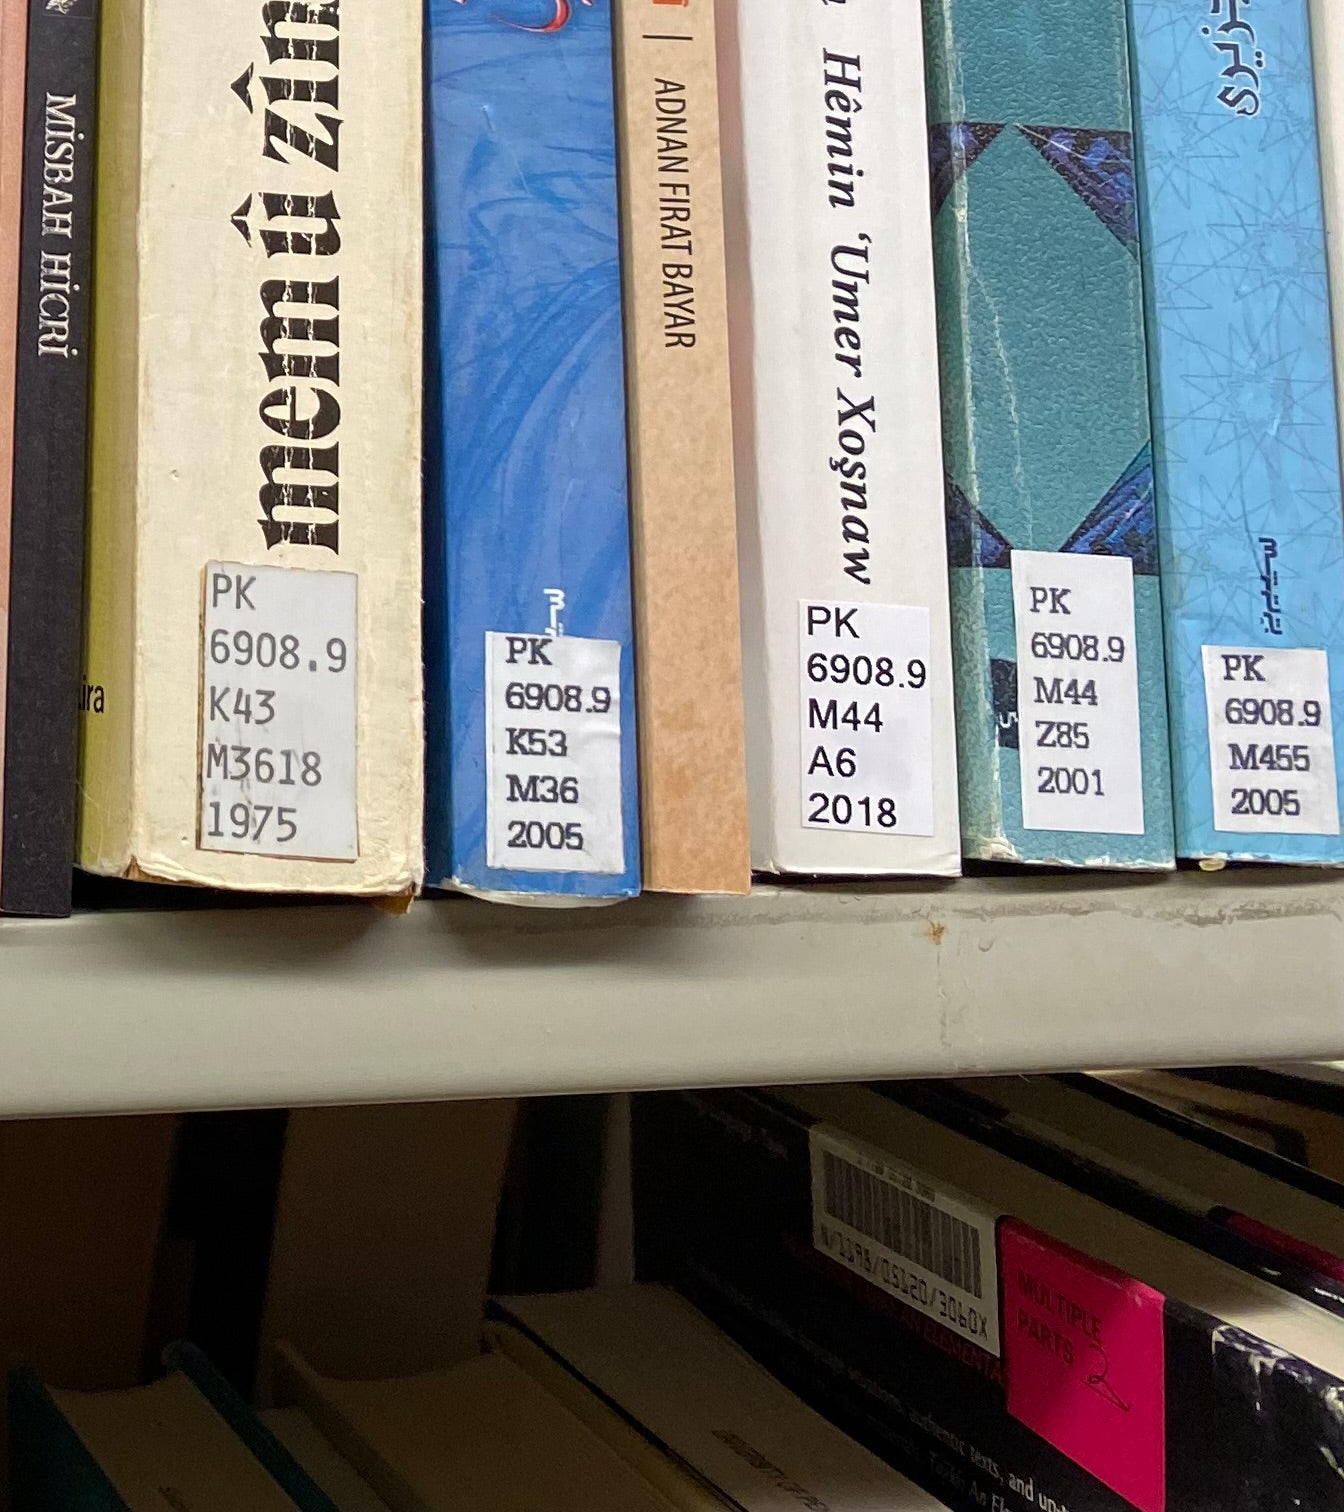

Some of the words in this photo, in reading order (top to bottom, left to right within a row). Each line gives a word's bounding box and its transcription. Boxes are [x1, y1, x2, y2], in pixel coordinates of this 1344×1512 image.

[655, 78, 688, 173] ADNAN
[823, 48, 862, 208] Hêmin
[659, 184, 693, 254] FIRAT
[662, 264, 696, 348] BAYAR
[829, 387, 874, 584] Xoşnaw
[211, 573, 256, 609] PK
[1030, 587, 1071, 615] PK
[806, 606, 859, 638] PK
[210, 629, 347, 672] 6908.9
[505, 637, 553, 665] PK
[1032, 632, 1125, 662] 6908.9
[806, 654, 926, 688] 6908.9
[1222, 654, 1265, 681] PK
[209, 686, 275, 724] K43
[505, 683, 611, 712] 6908.9
[1033, 678, 1098, 705] M44
[807, 702, 883, 731] M44
[1225, 699, 1321, 726] 6908.9
[506, 730, 568, 757] K53
[1035, 721, 1089, 749] Z85
[207, 744, 323, 786] M3618
[807, 747, 856, 777] A6
[1229, 744, 1310, 771] M455
[506, 775, 578, 803] M36
[1038, 767, 1104, 796] 2001
[807, 793, 897, 826] 2018
[1231, 789, 1300, 815] 2005
[207, 801, 297, 841] 1975
[507, 821, 583, 850] 2005
[1017, 1267, 1103, 1342] MULTIPLE
[1017, 1308, 1076, 1366] PARTS
